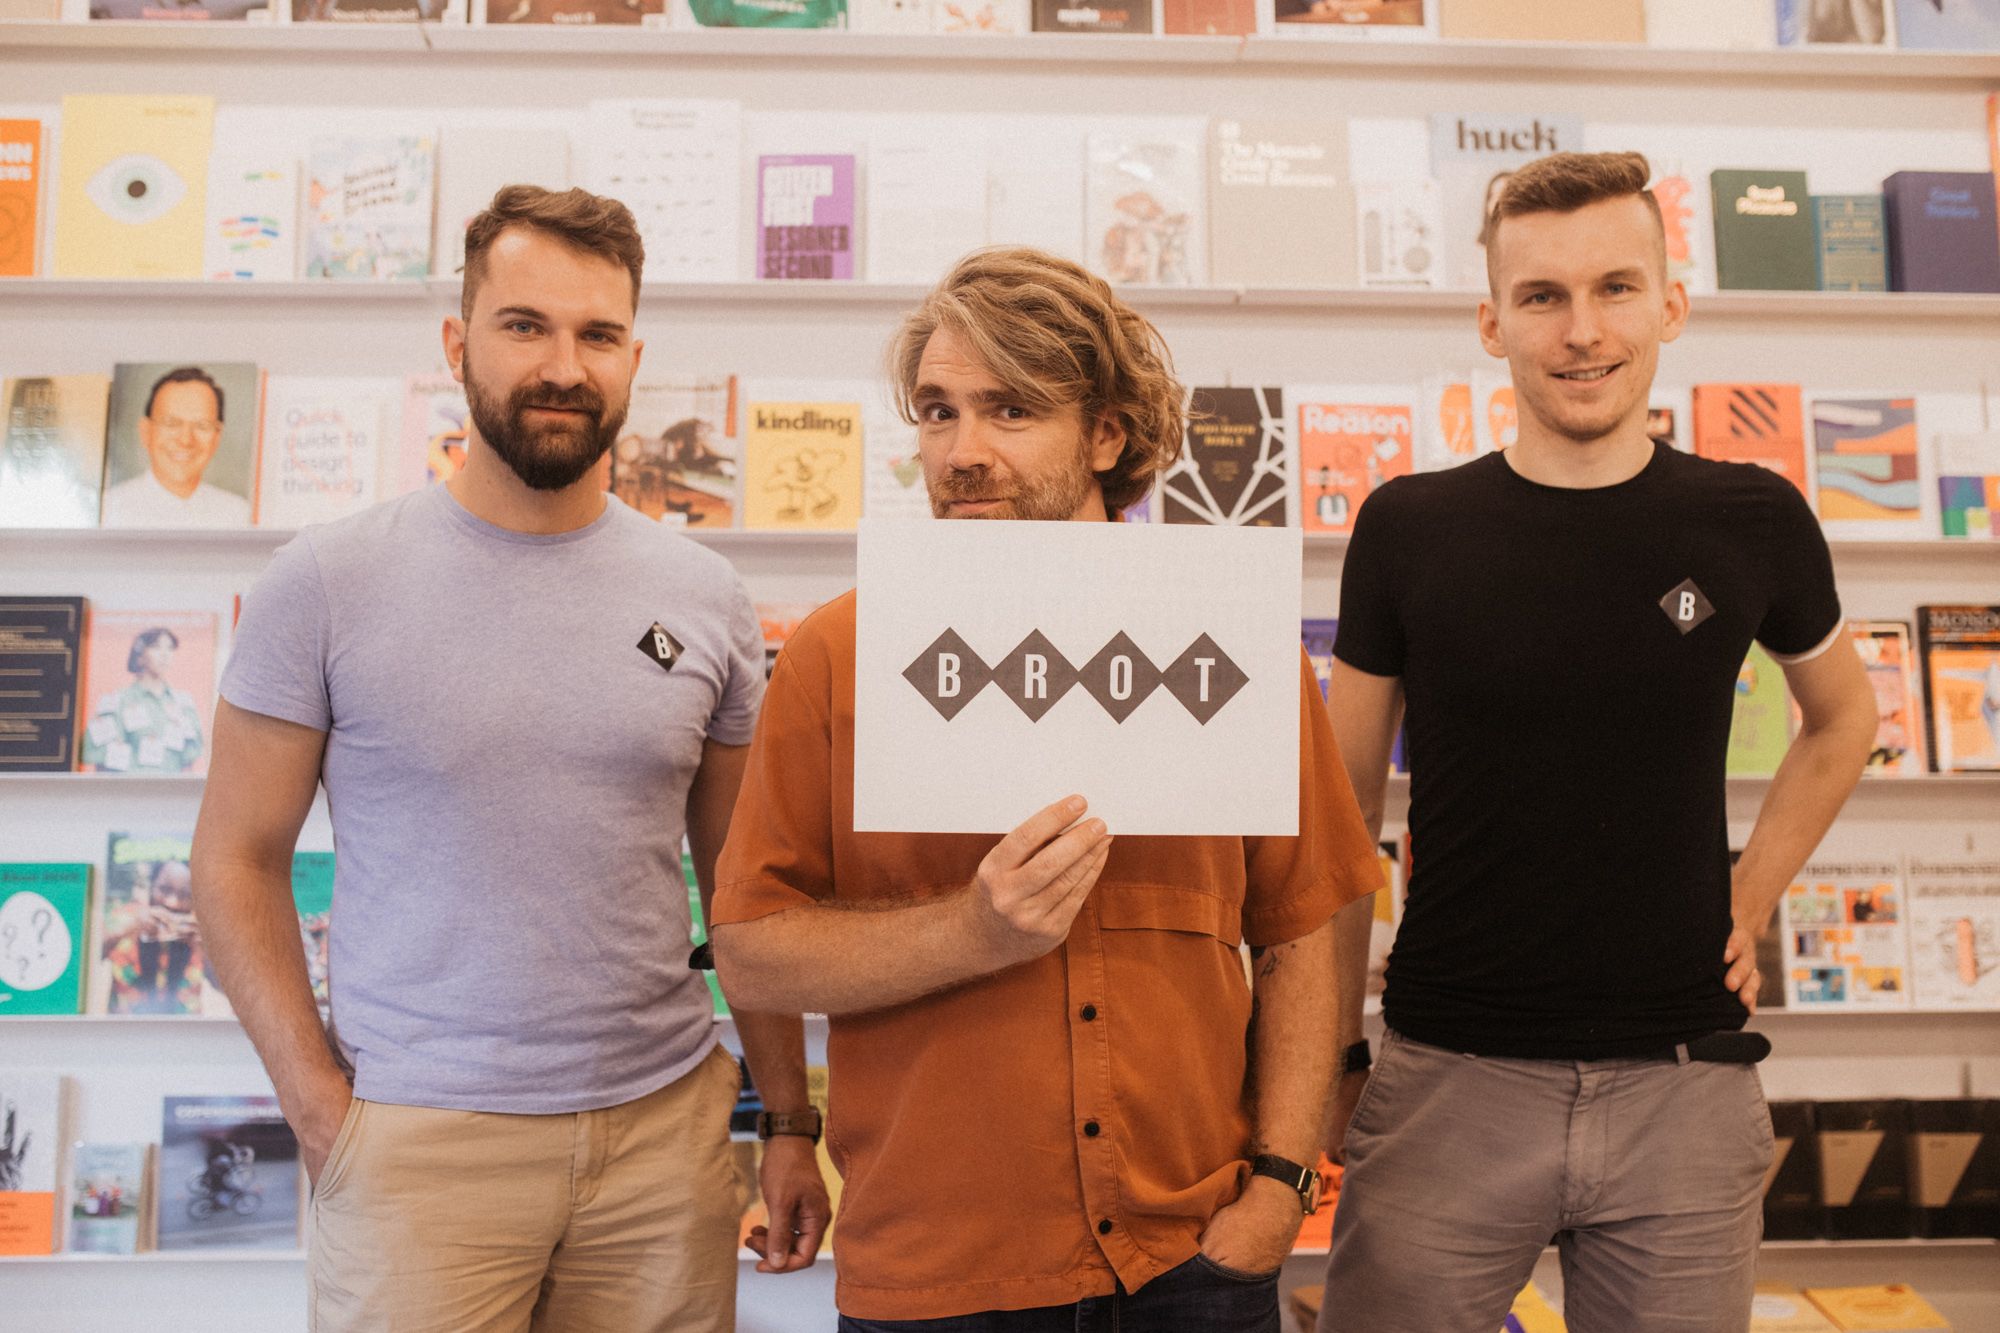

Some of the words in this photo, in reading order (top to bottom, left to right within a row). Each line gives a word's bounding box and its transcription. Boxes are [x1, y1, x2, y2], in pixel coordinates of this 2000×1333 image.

[1457, 119, 1557, 151] huck
[285, 407, 344, 429] Quick
[757, 410, 852, 437] kindling
[1304, 406, 1410, 435] Reason
[346, 429, 368, 449] to
[1679, 591, 1696, 621] B
[653, 632, 672, 659] B
[937, 652, 1216, 703] BROT
